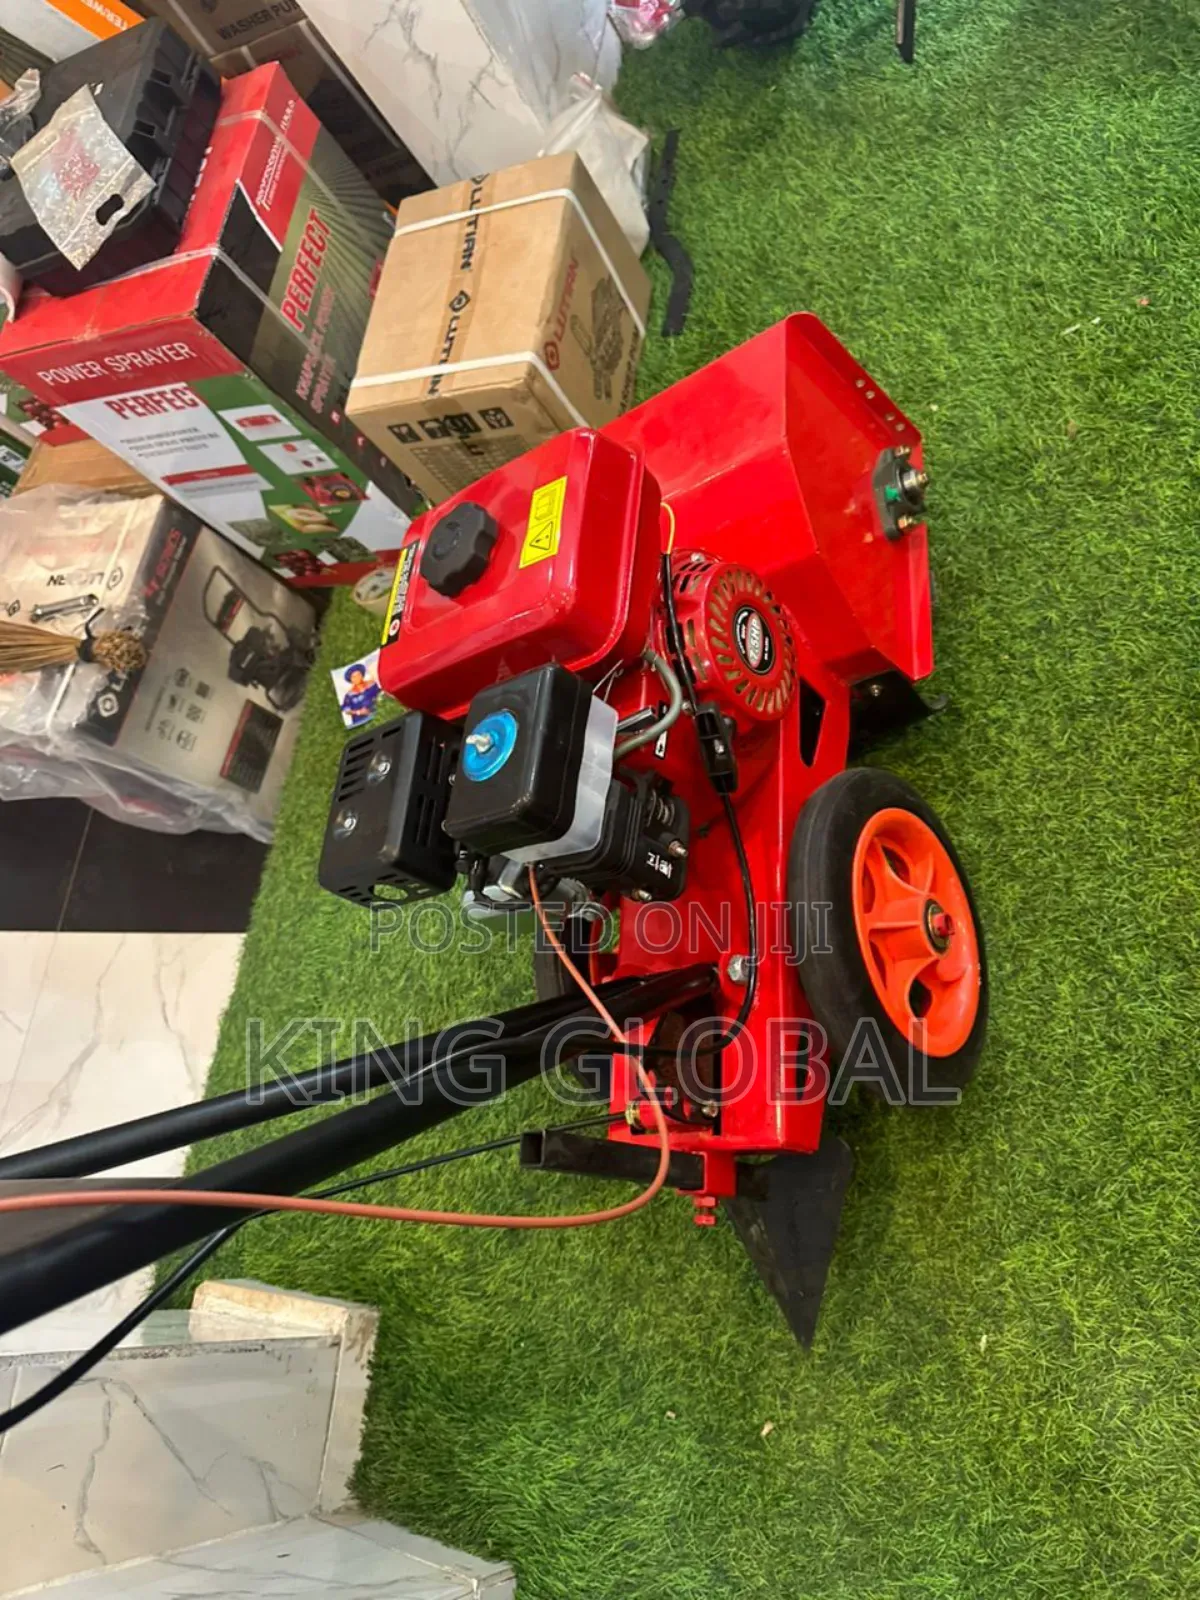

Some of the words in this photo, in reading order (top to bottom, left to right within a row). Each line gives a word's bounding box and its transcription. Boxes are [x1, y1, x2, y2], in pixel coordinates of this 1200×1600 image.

[281, 206, 331, 332] PERFECT
[37, 360, 109, 386] POWER
[104, 342, 197, 373] SPRAYER
[428, 314, 460, 396] LUTIN
